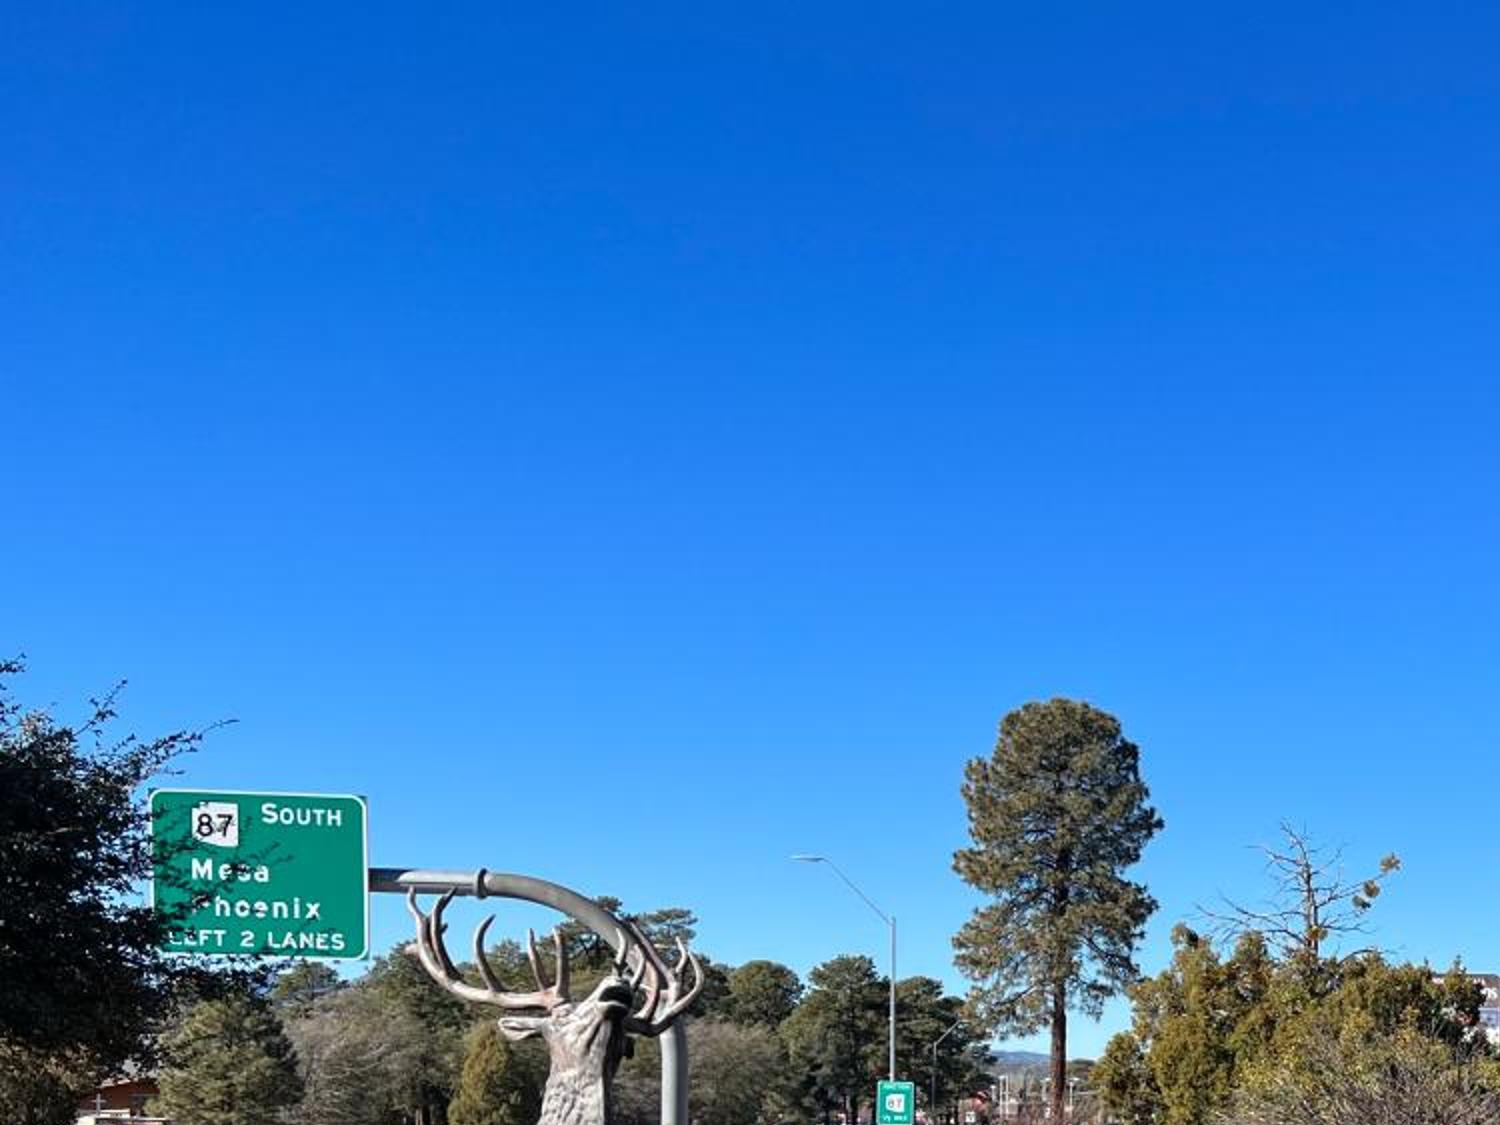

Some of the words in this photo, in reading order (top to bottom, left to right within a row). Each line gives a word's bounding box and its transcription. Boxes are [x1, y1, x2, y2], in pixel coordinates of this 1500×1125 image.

[196, 812, 233, 838] 87
[261, 802, 343, 827] SOUTH
[240, 929, 255, 948] 2
[267, 931, 346, 951] LANES
